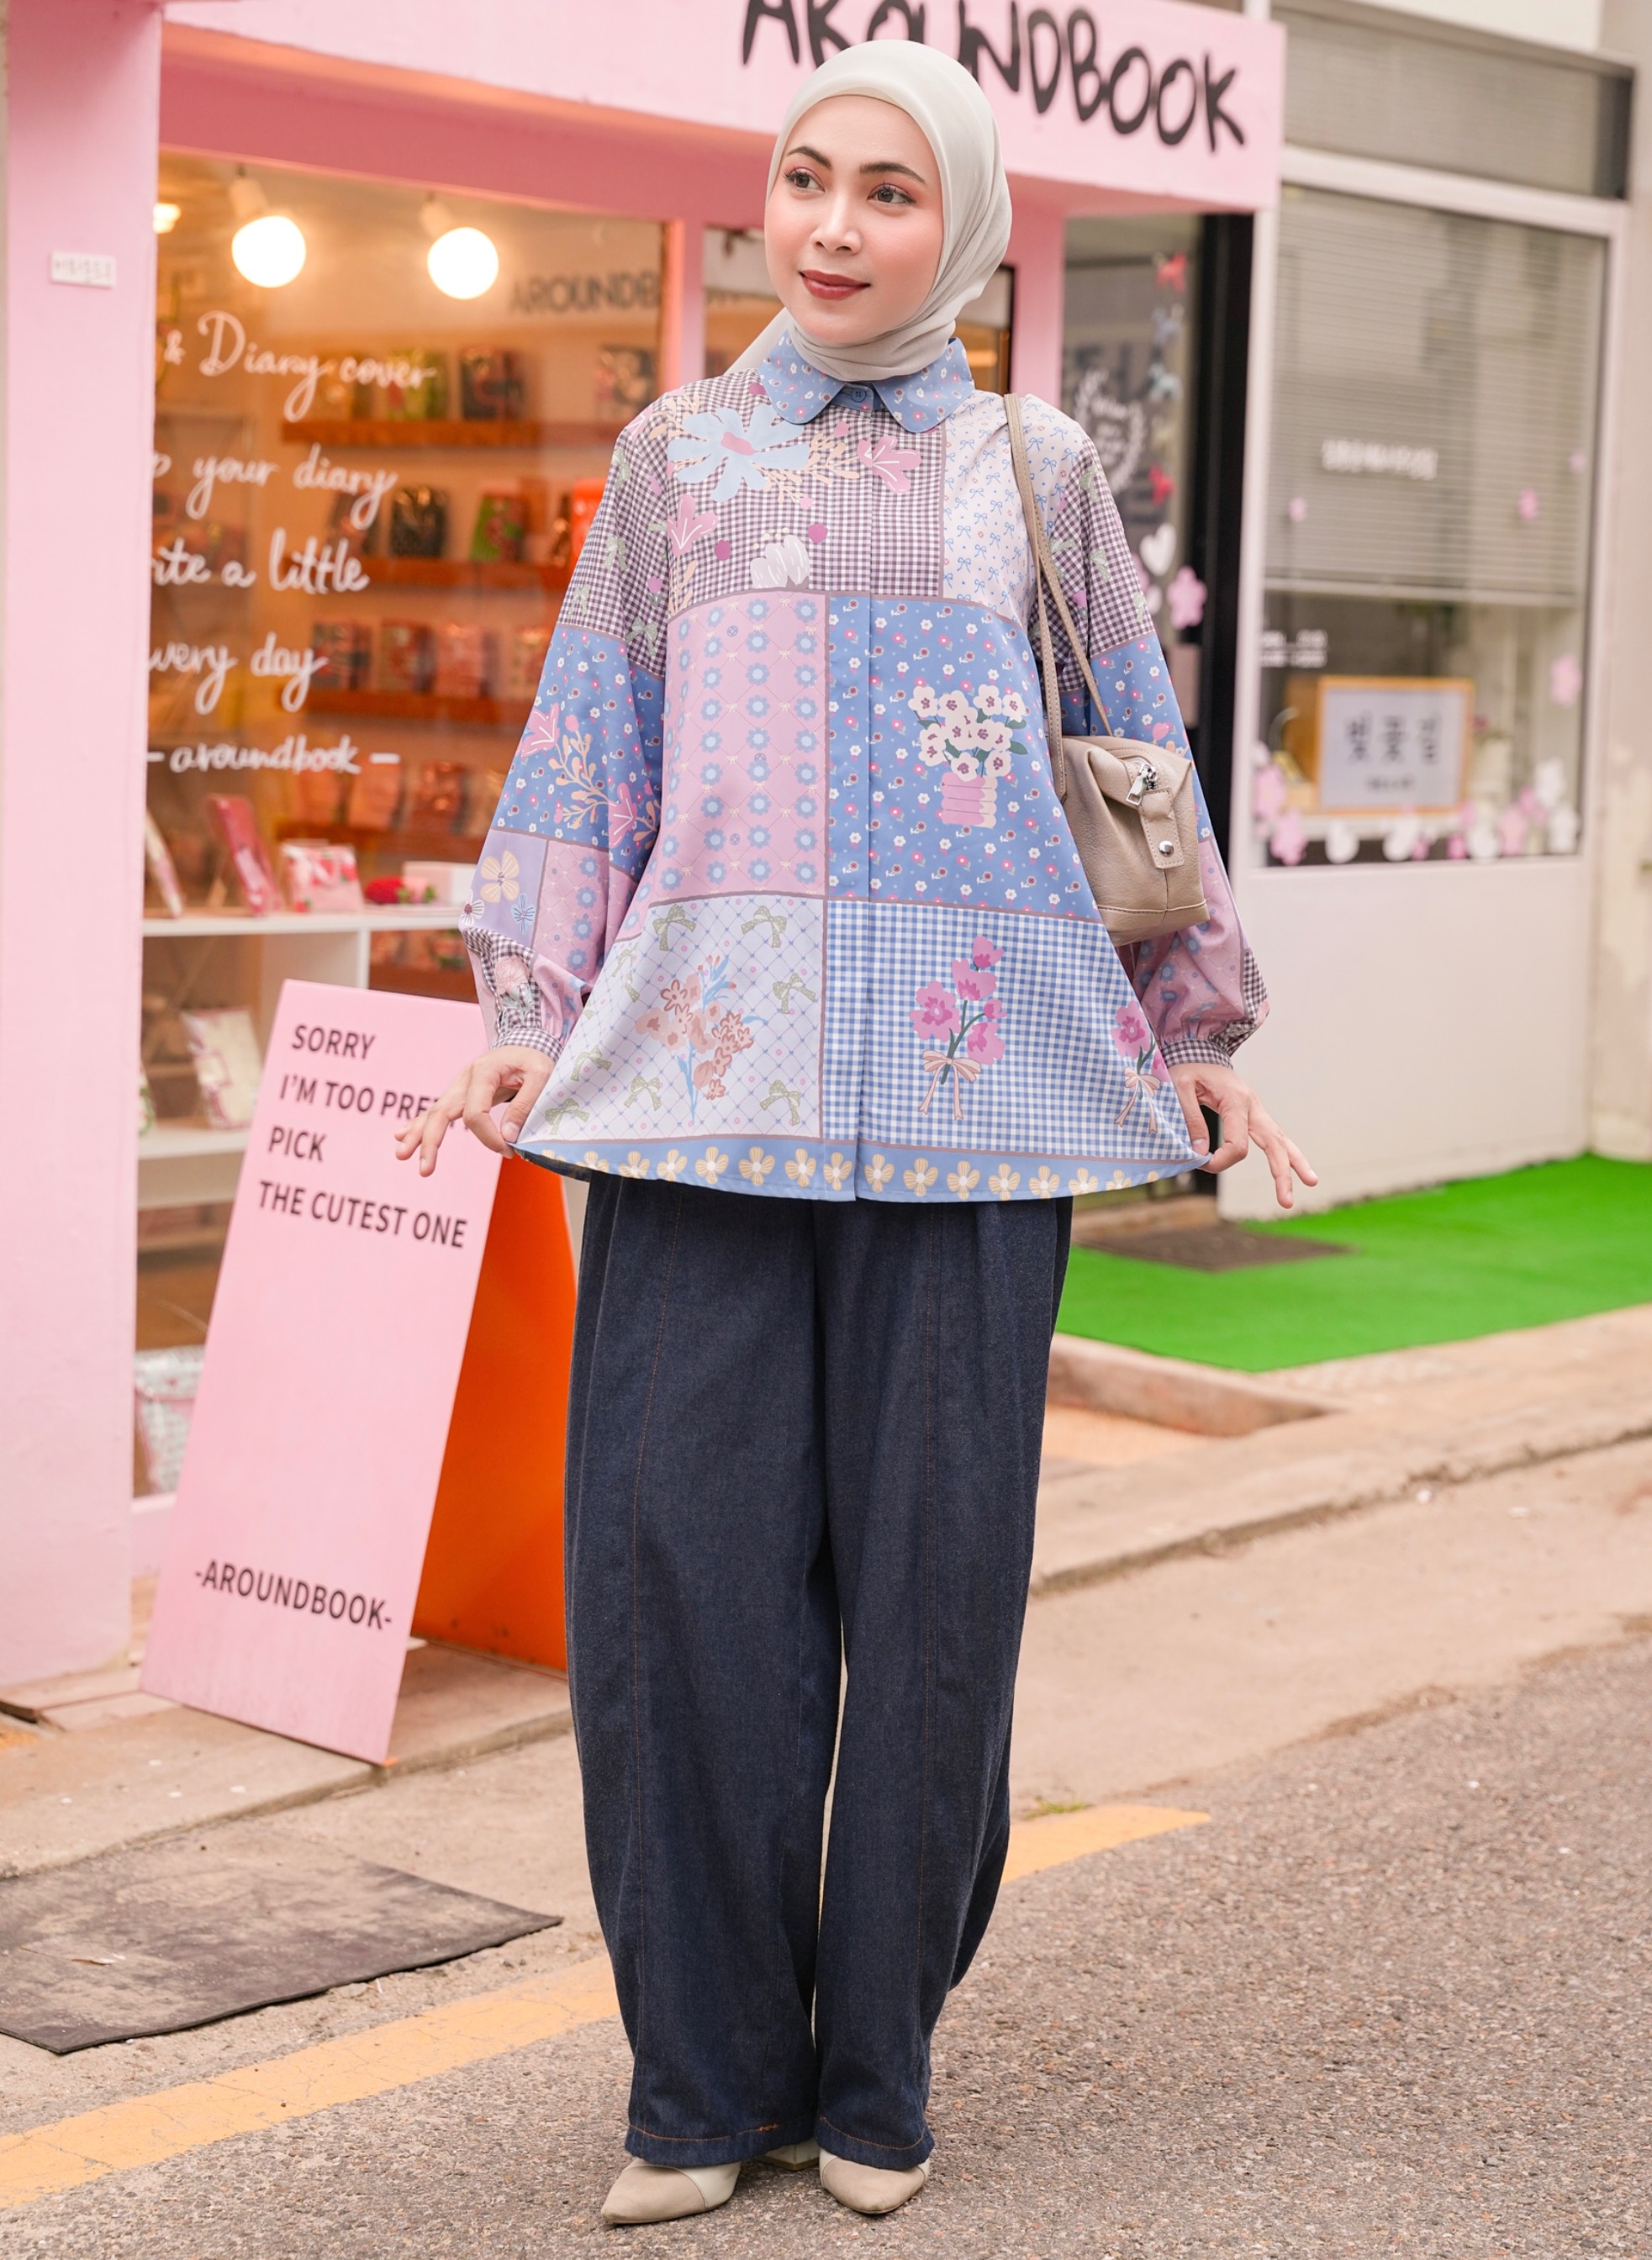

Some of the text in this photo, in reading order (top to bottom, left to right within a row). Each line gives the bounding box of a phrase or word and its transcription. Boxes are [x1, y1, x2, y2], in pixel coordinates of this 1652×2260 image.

[197, 310, 330, 422] Diary
[340, 356, 437, 389] cover
[186, 442, 398, 530] your diary
[152, 527, 371, 594] ite a little
[149, 631, 330, 715] very day
[292, 1024, 376, 1060] SORRY
[279, 1074, 316, 1106] I'M
[325, 1081, 375, 1114] TOO
[267, 1127, 326, 1162] PICK
[258, 1180, 468, 1249] THE CUTEST ONE
[195, 1560, 393, 1629] -AROUNDBOOK-
